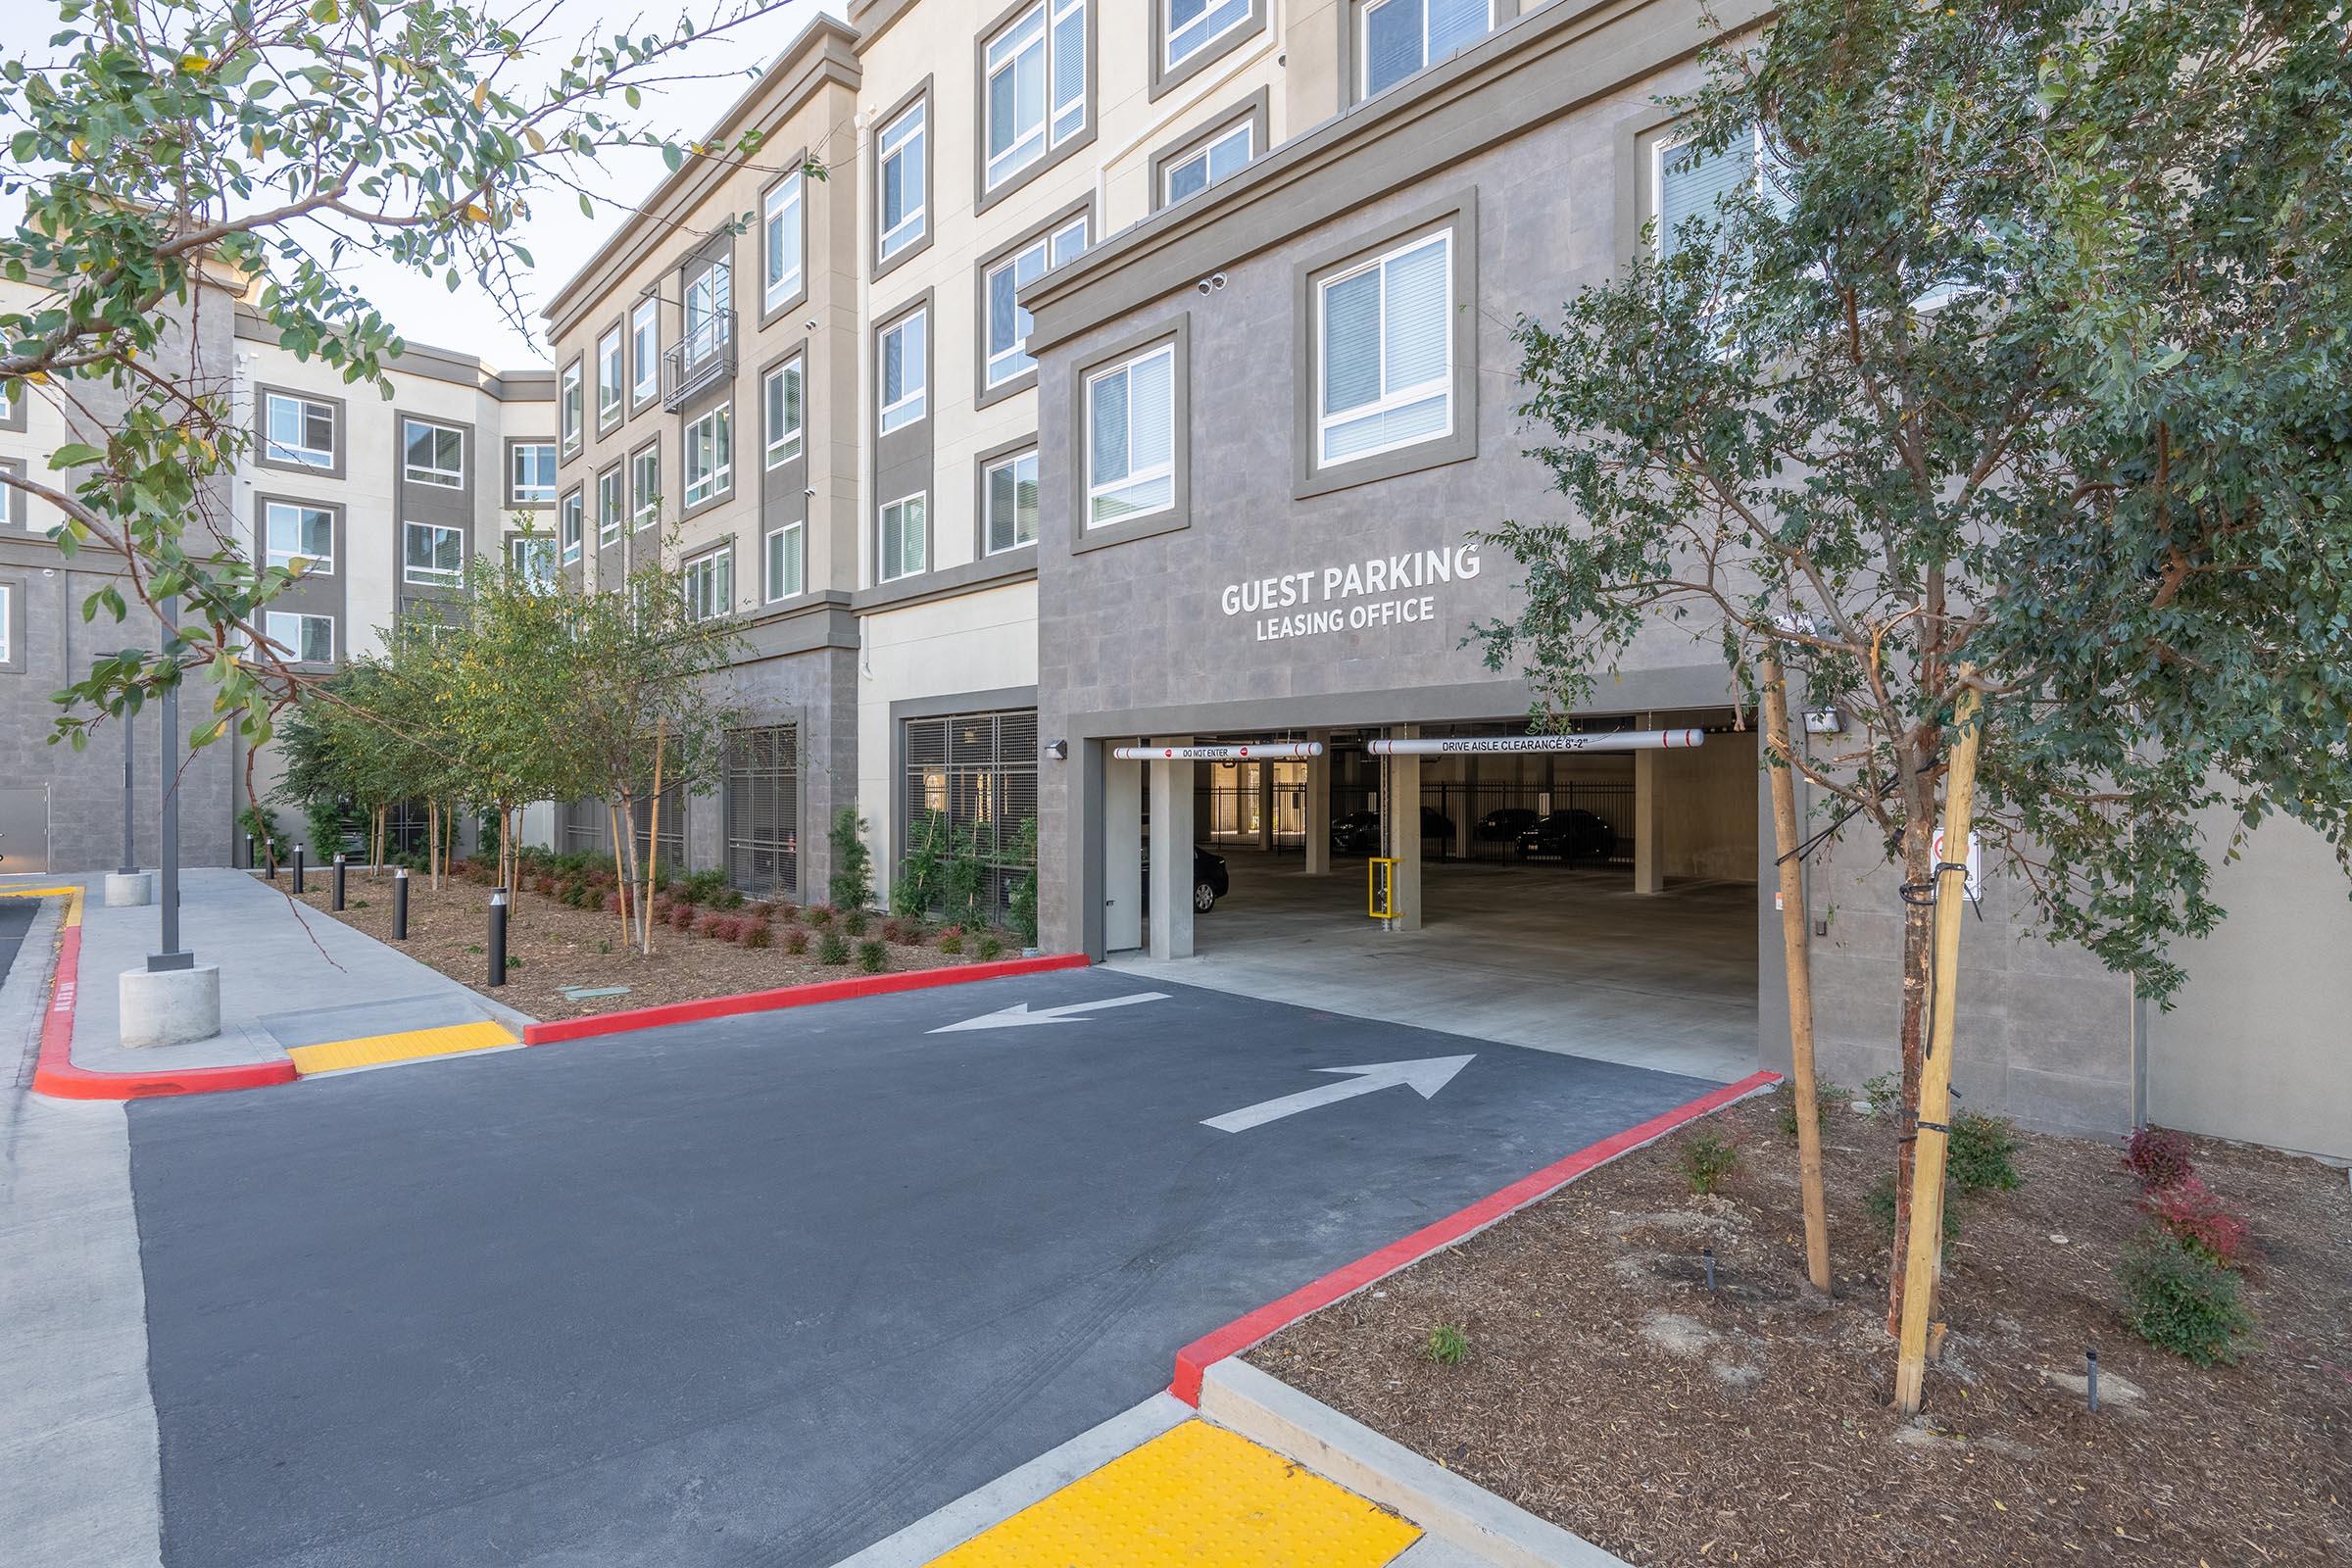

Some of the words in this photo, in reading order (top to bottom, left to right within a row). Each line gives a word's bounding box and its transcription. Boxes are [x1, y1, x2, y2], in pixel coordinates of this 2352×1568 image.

[1221, 571, 1314, 616] GUEST
[1324, 543, 1481, 601] PARKING
[1256, 609, 1344, 642] LEASING
[1349, 596, 1435, 629] OFFICE
[1183, 749, 1193, 758] DO
[1194, 749, 1206, 758] NOT
[1207, 748, 1229, 758] ENTER
[1443, 742, 1469, 752] DRIVE
[1472, 741, 1498, 751] AISLE
[1501, 740, 1563, 751] CLEARANCE
